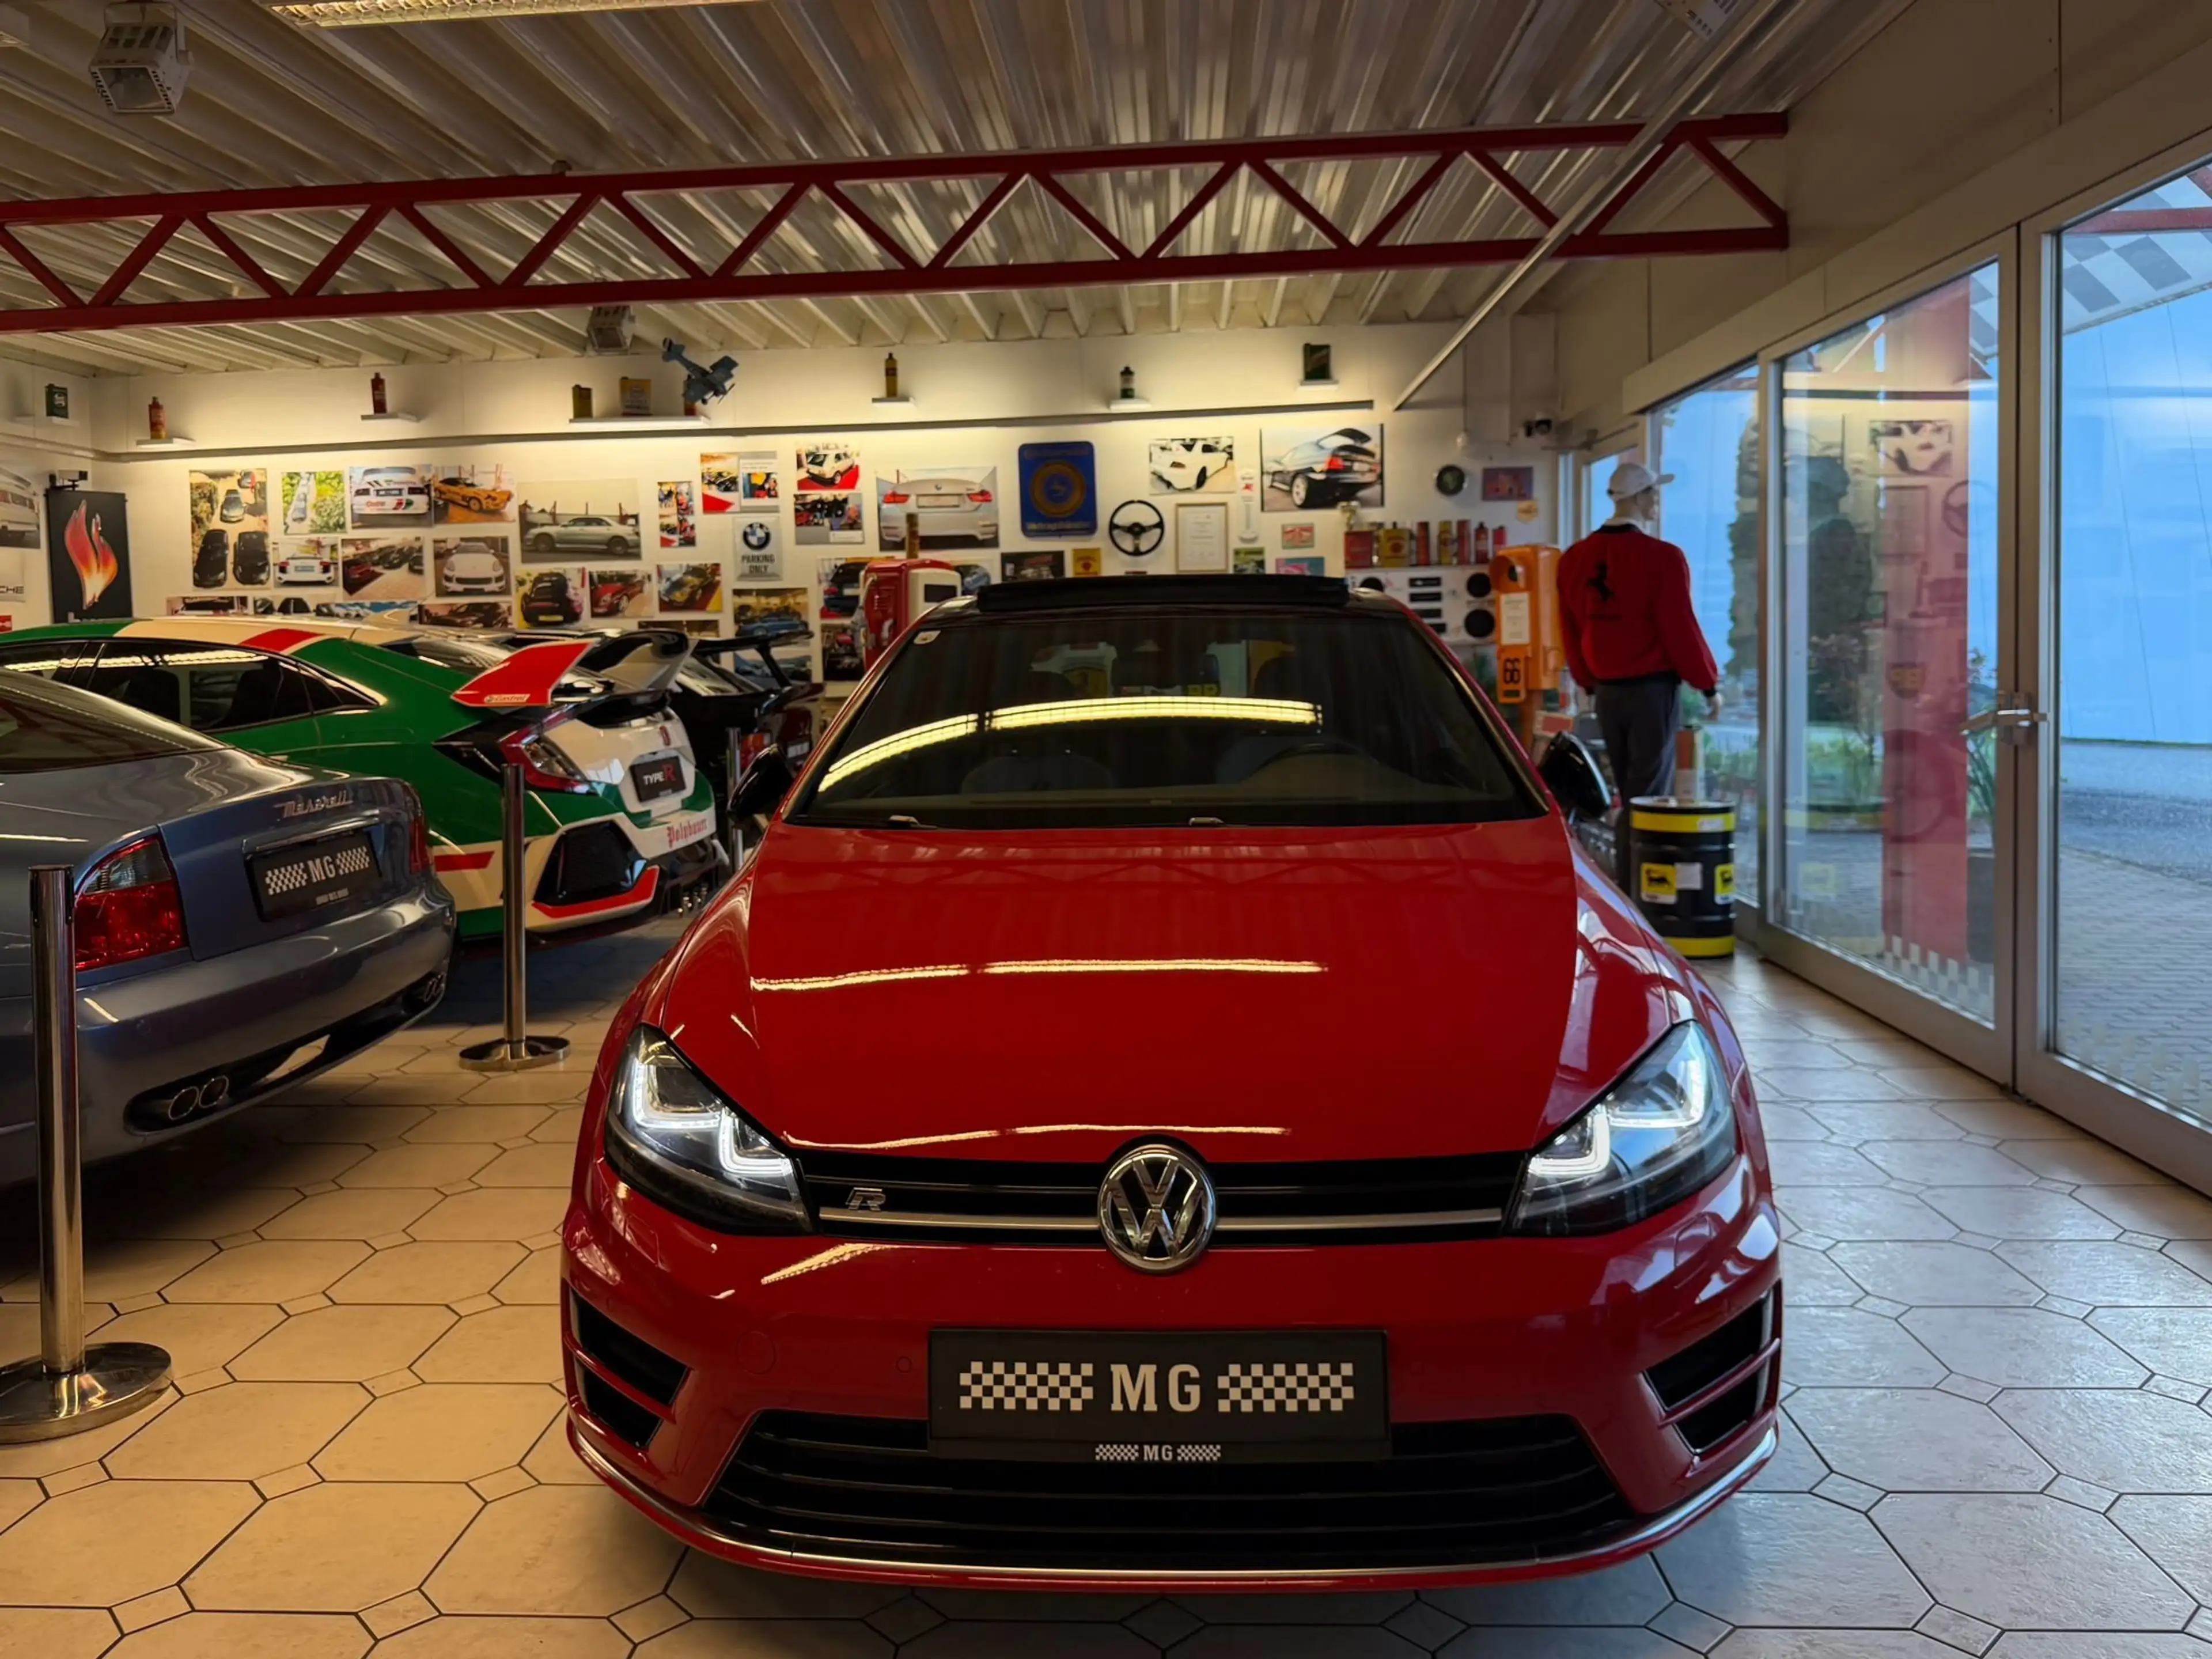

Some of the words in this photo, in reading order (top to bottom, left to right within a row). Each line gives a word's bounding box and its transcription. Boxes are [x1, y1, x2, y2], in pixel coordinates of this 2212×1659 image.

[741, 553, 775, 563] PARKING
[749, 565, 768, 574] ONLY
[642, 771, 665, 786] TYPE
[662, 763, 676, 781] R
[307, 855, 336, 883] MG
[846, 1187, 886, 1211] R
[1110, 1363, 1201, 1412] MG
[1143, 1444, 1173, 1461] MG
